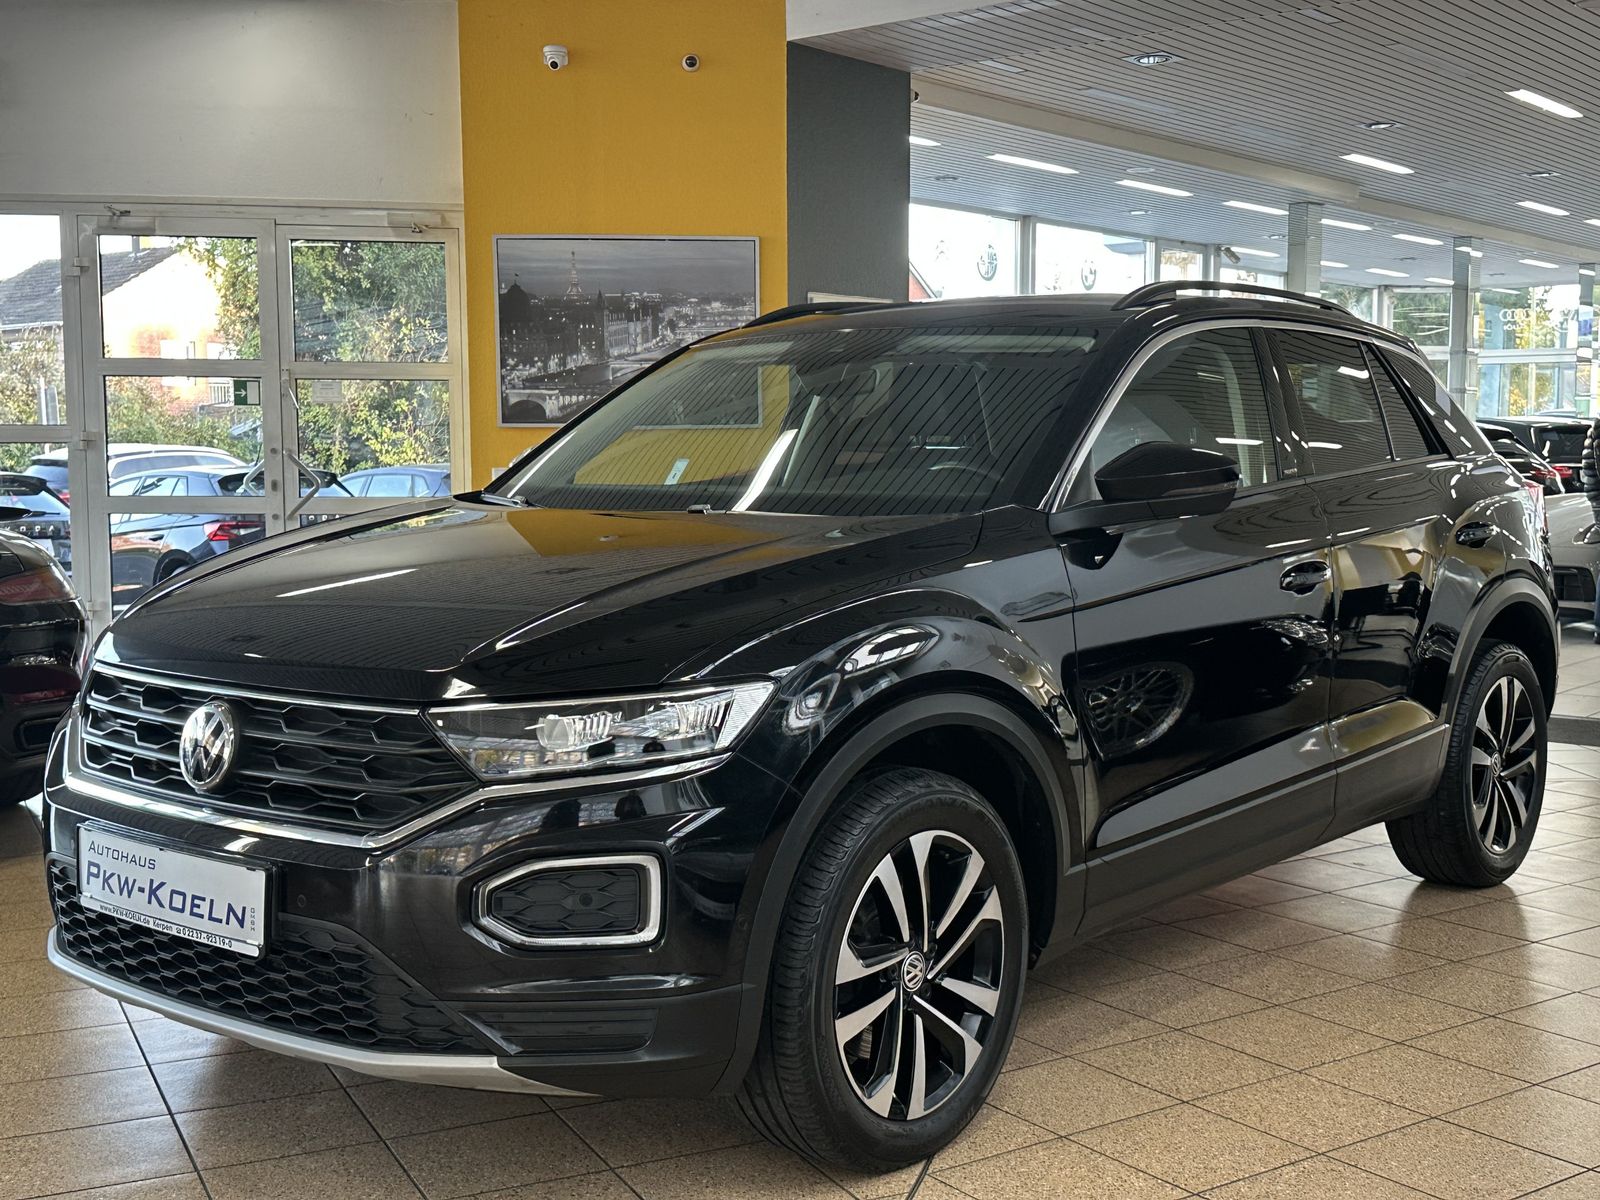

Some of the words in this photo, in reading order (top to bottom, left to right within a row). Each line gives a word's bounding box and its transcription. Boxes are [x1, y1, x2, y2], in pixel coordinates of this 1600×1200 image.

[88, 840, 156, 870] AUTOHAUS
[86, 860, 247, 929] PKW-KOELN
[152, 917, 173, 932] Kerpen
